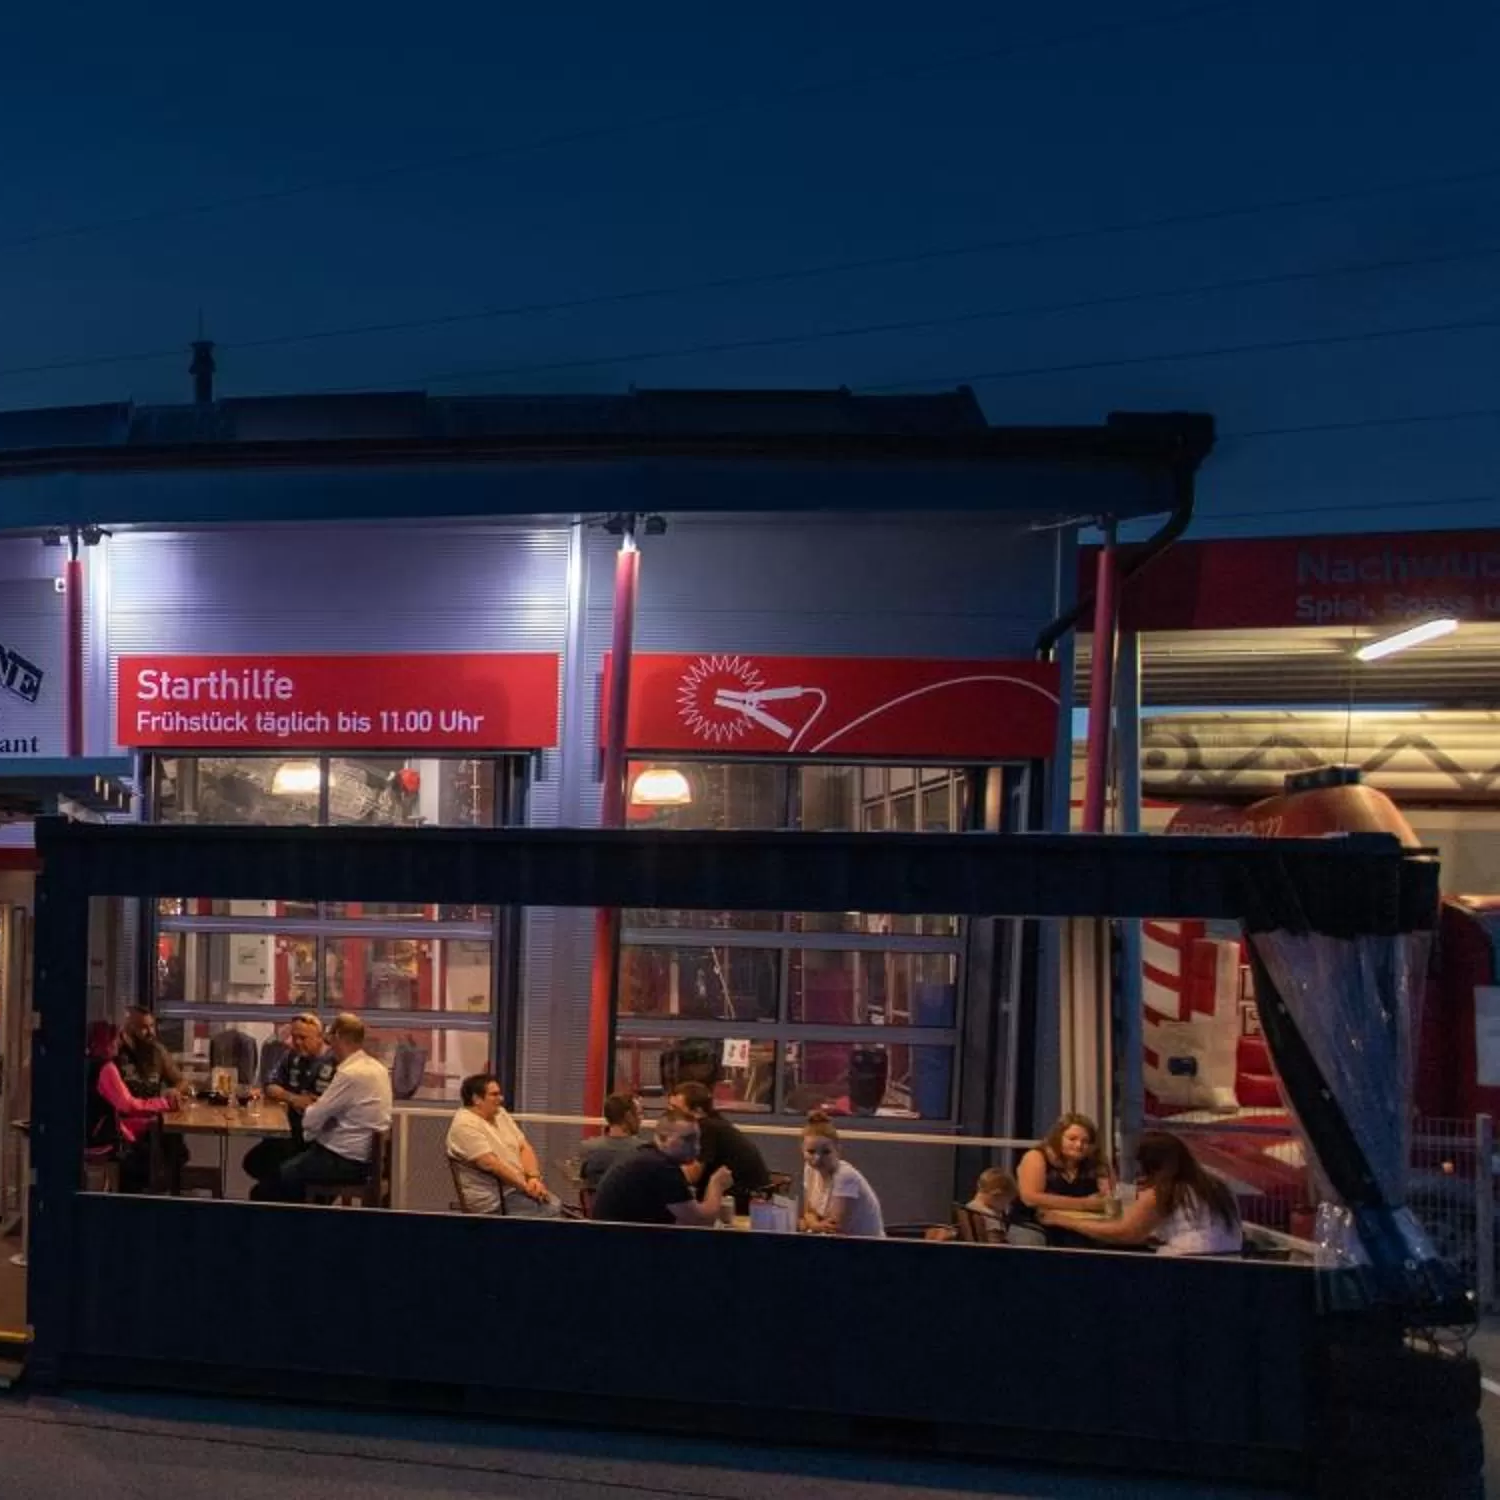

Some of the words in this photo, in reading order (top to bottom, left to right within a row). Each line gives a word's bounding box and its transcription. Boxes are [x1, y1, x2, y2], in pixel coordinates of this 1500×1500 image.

[137, 668, 293, 700] Starthilfe
[137, 710, 248, 732] Frühstück
[256, 710, 330, 736] täglich
[337, 710, 372, 733] bis
[379, 710, 433, 733] 11.00
[439, 710, 485, 733] Uhr
